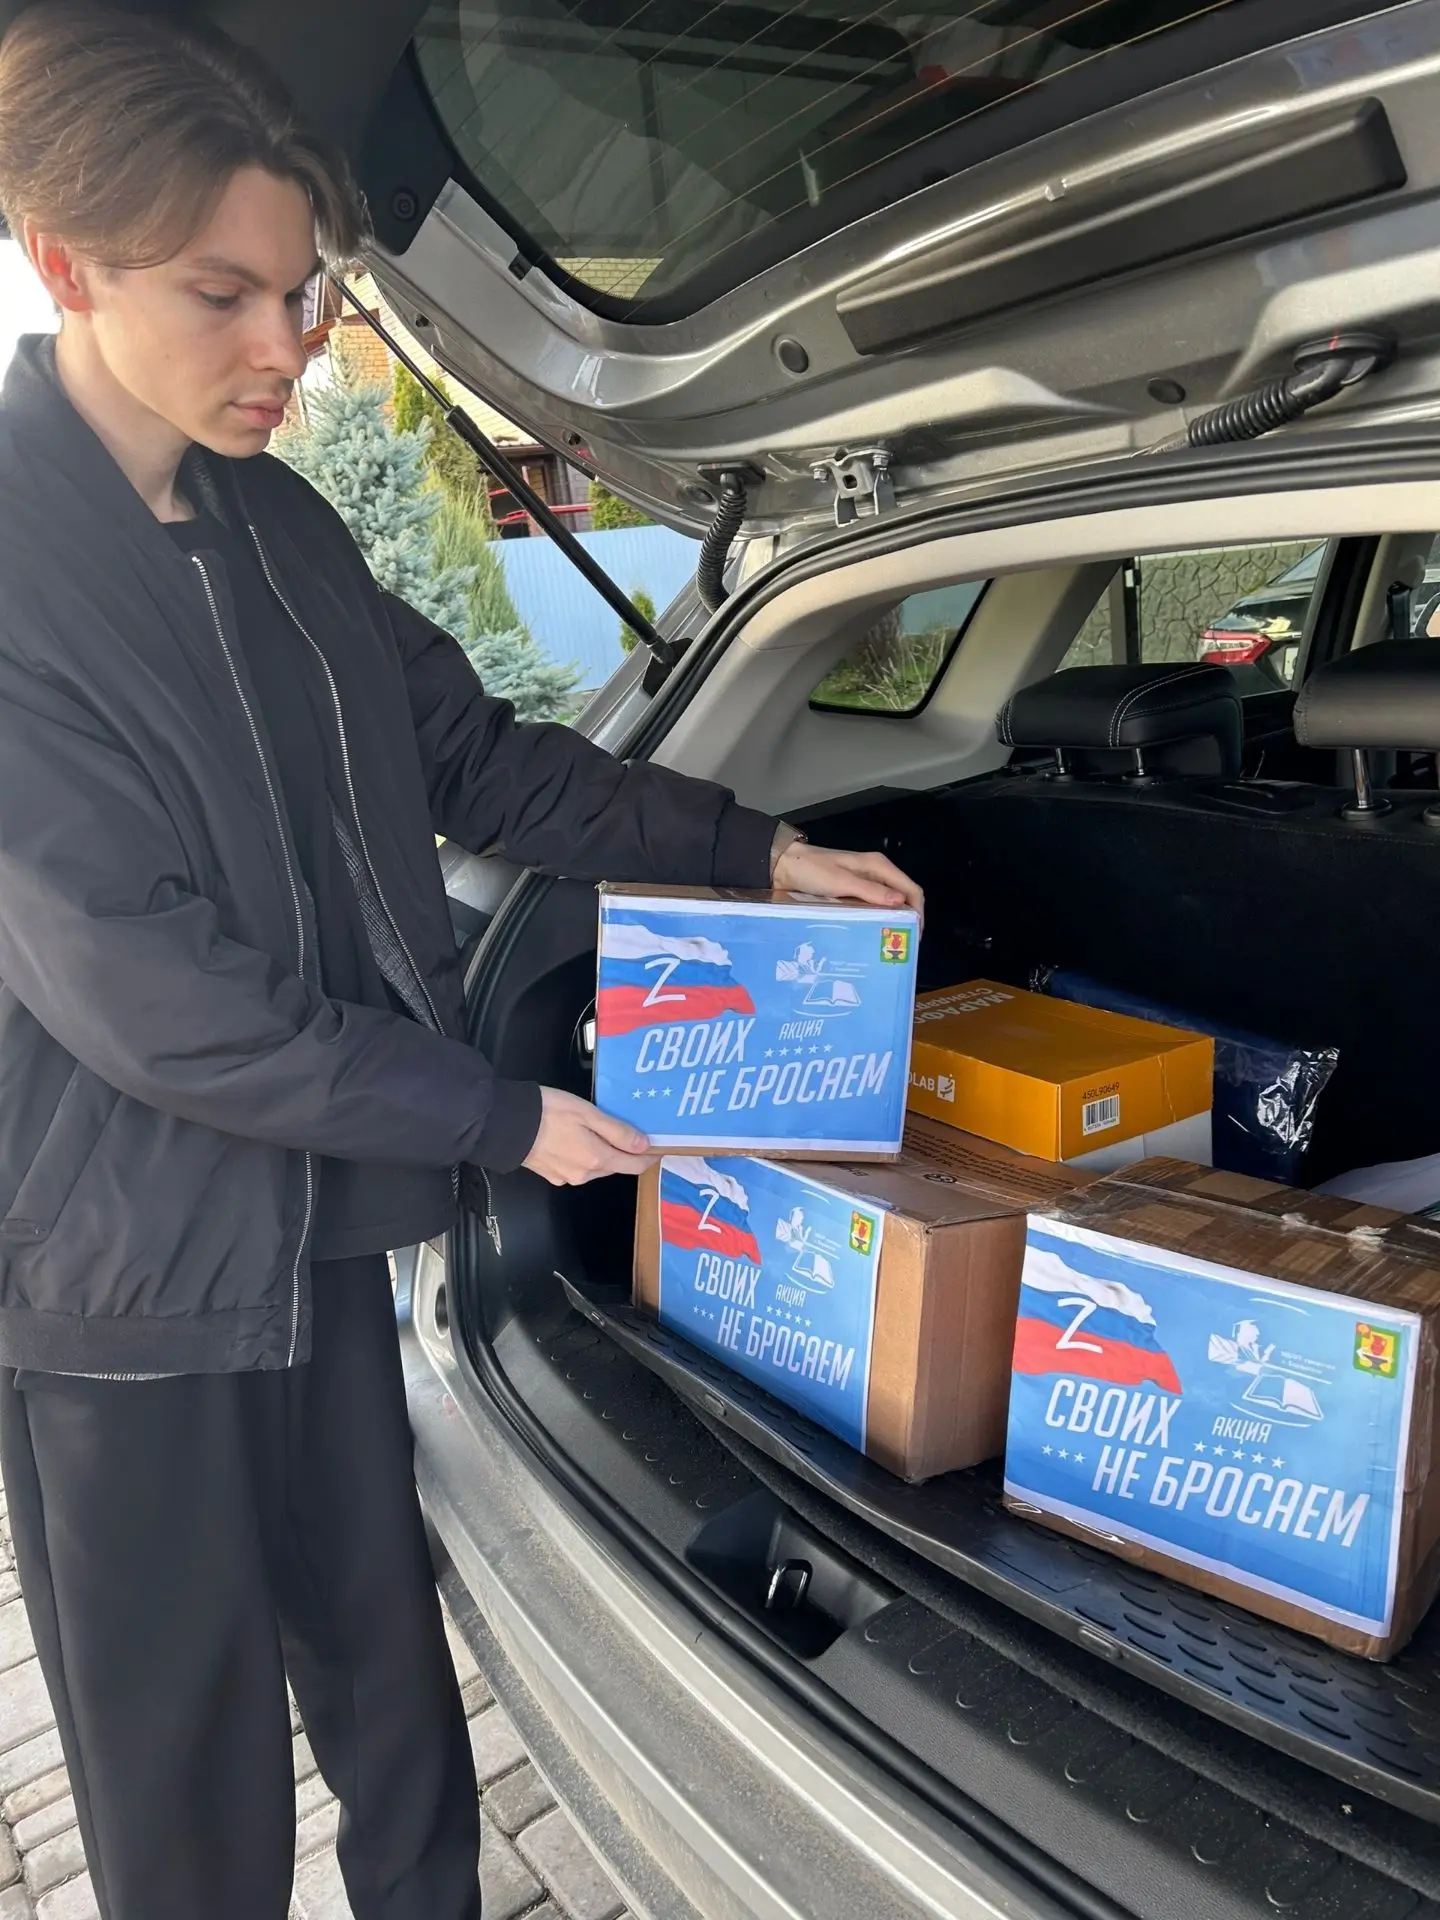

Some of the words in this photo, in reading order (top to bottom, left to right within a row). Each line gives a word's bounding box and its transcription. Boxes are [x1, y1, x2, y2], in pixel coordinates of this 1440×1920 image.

[642, 957, 686, 1008] Z
[635, 1017, 756, 1073] СВОИХ
[778, 1019, 825, 1041] АКЦИЯ
[676, 1069, 727, 1117] НЕ
[727, 1050, 893, 1111] БРОСАЕМ
[697, 1188, 722, 1234] Z
[694, 1252, 762, 1309] СВОИХ
[775, 1283, 807, 1308] АКЦИЯ
[717, 1306, 743, 1351] НЕ
[745, 1319, 855, 1391] БРОСАЕМ
[1055, 1297, 1103, 1353] Z
[1045, 1378, 1182, 1449] СВОИХ
[1211, 1416, 1272, 1445] АКЦИЯ
[1092, 1446, 1148, 1497] НЕ
[1149, 1455, 1370, 1548] БРОСАЕМ
